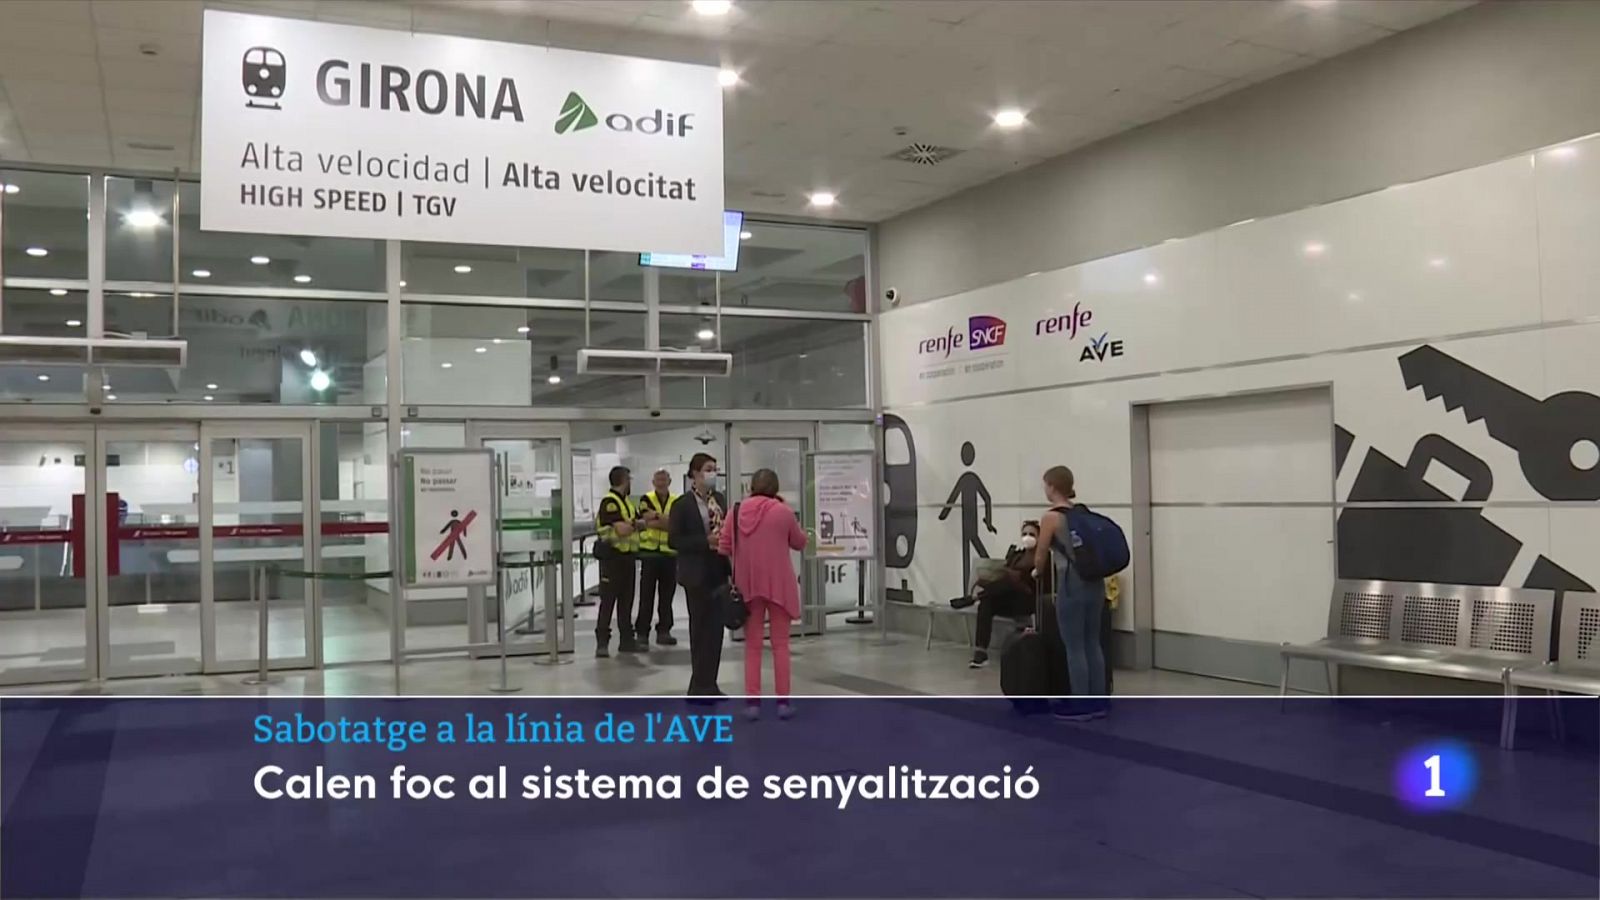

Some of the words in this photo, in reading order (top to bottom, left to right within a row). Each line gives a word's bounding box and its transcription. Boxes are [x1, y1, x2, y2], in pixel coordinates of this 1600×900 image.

[317, 59, 524, 123] GIRONA
[605, 109, 695, 137] adif
[240, 142, 303, 172] Alta
[318, 150, 469, 184] velocidad
[502, 163, 560, 191] Alta
[572, 169, 697, 201] velocitat
[241, 184, 303, 208] HIGH
[314, 188, 387, 213] SPEED
[412, 195, 457, 217] TGV
[1035, 301, 1093, 340] renfe
[919, 325, 964, 359] renfe
[970, 325, 1005, 347] SNCF
[1079, 333, 1124, 362] AVE
